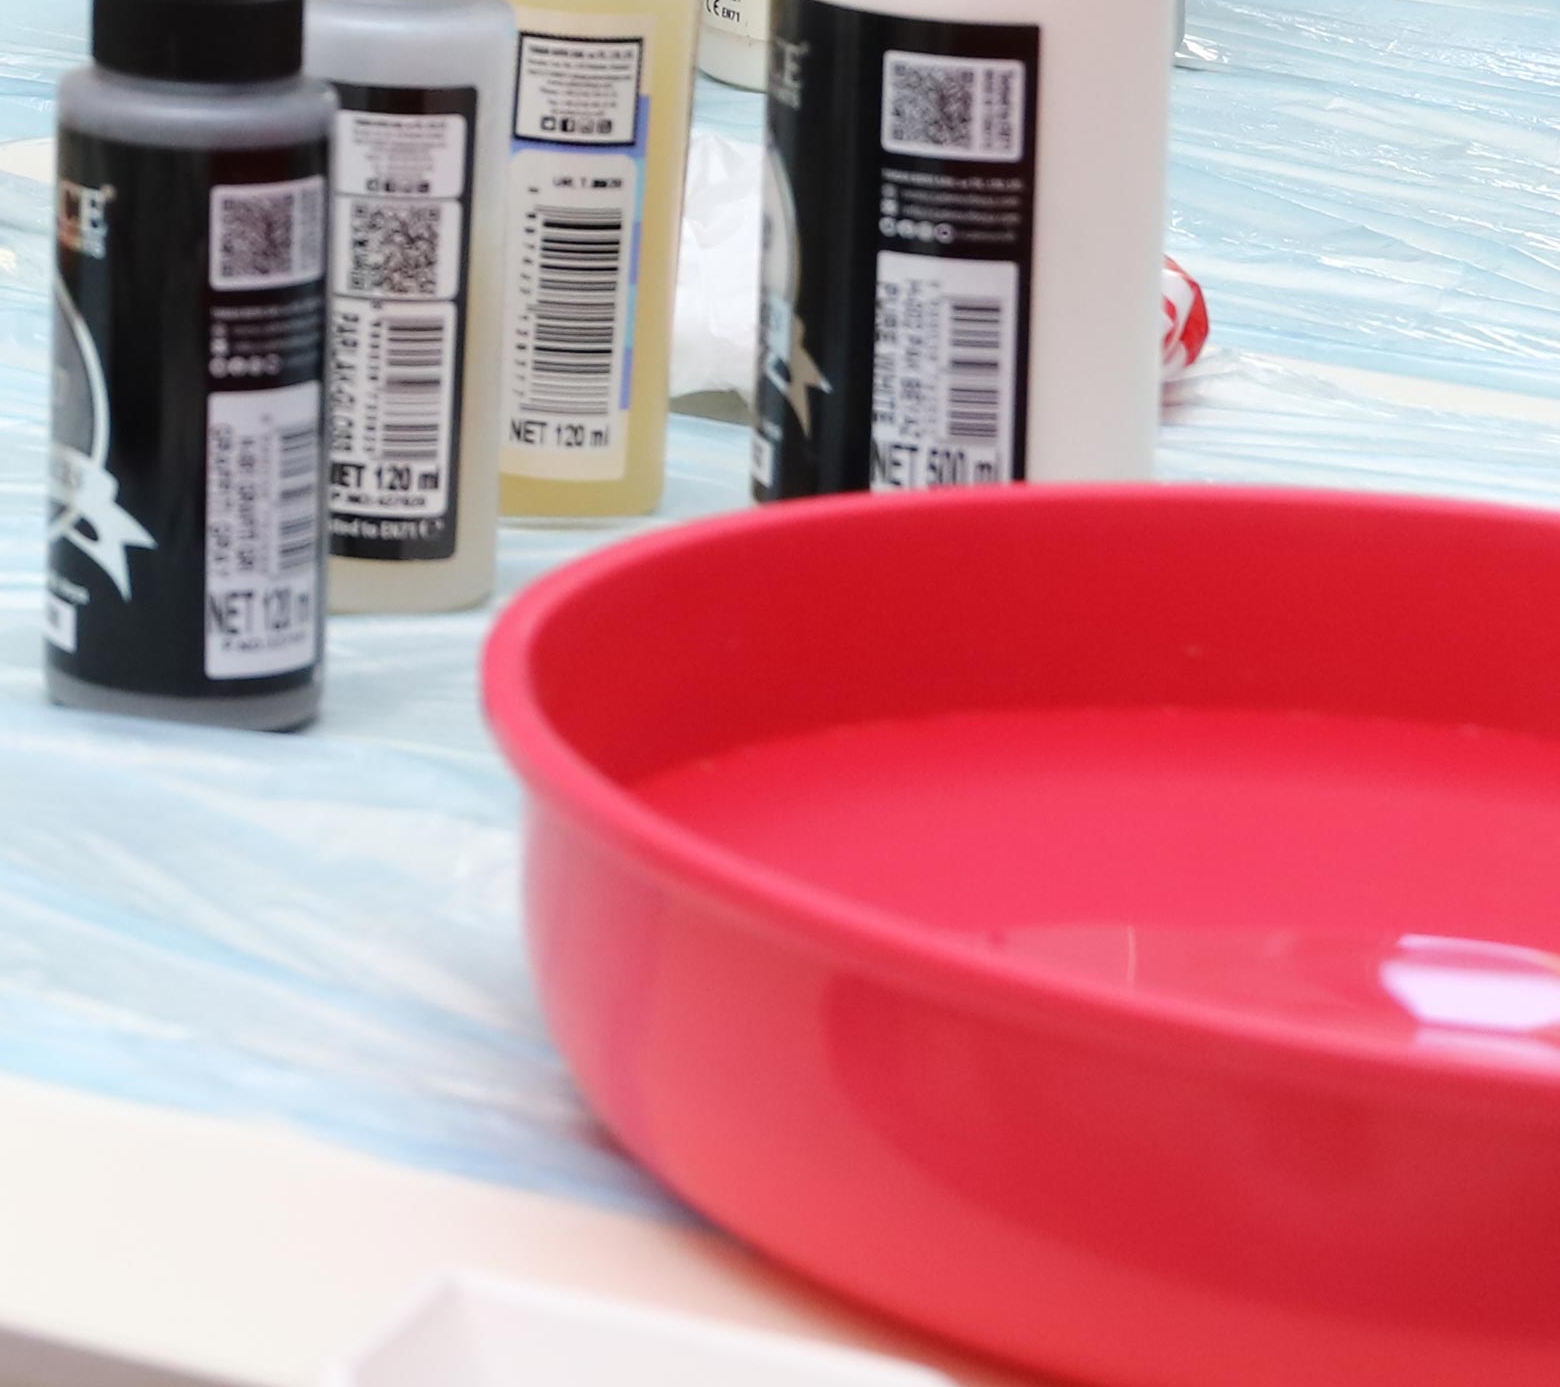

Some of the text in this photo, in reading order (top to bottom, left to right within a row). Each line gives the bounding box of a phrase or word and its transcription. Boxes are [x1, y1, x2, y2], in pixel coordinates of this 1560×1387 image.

[721, 7, 740, 22] EN71
[509, 420, 608, 447] NET 120 ml
[871, 435, 918, 487] NET
[928, 447, 965, 485] 500
[376, 465, 411, 490] 120
